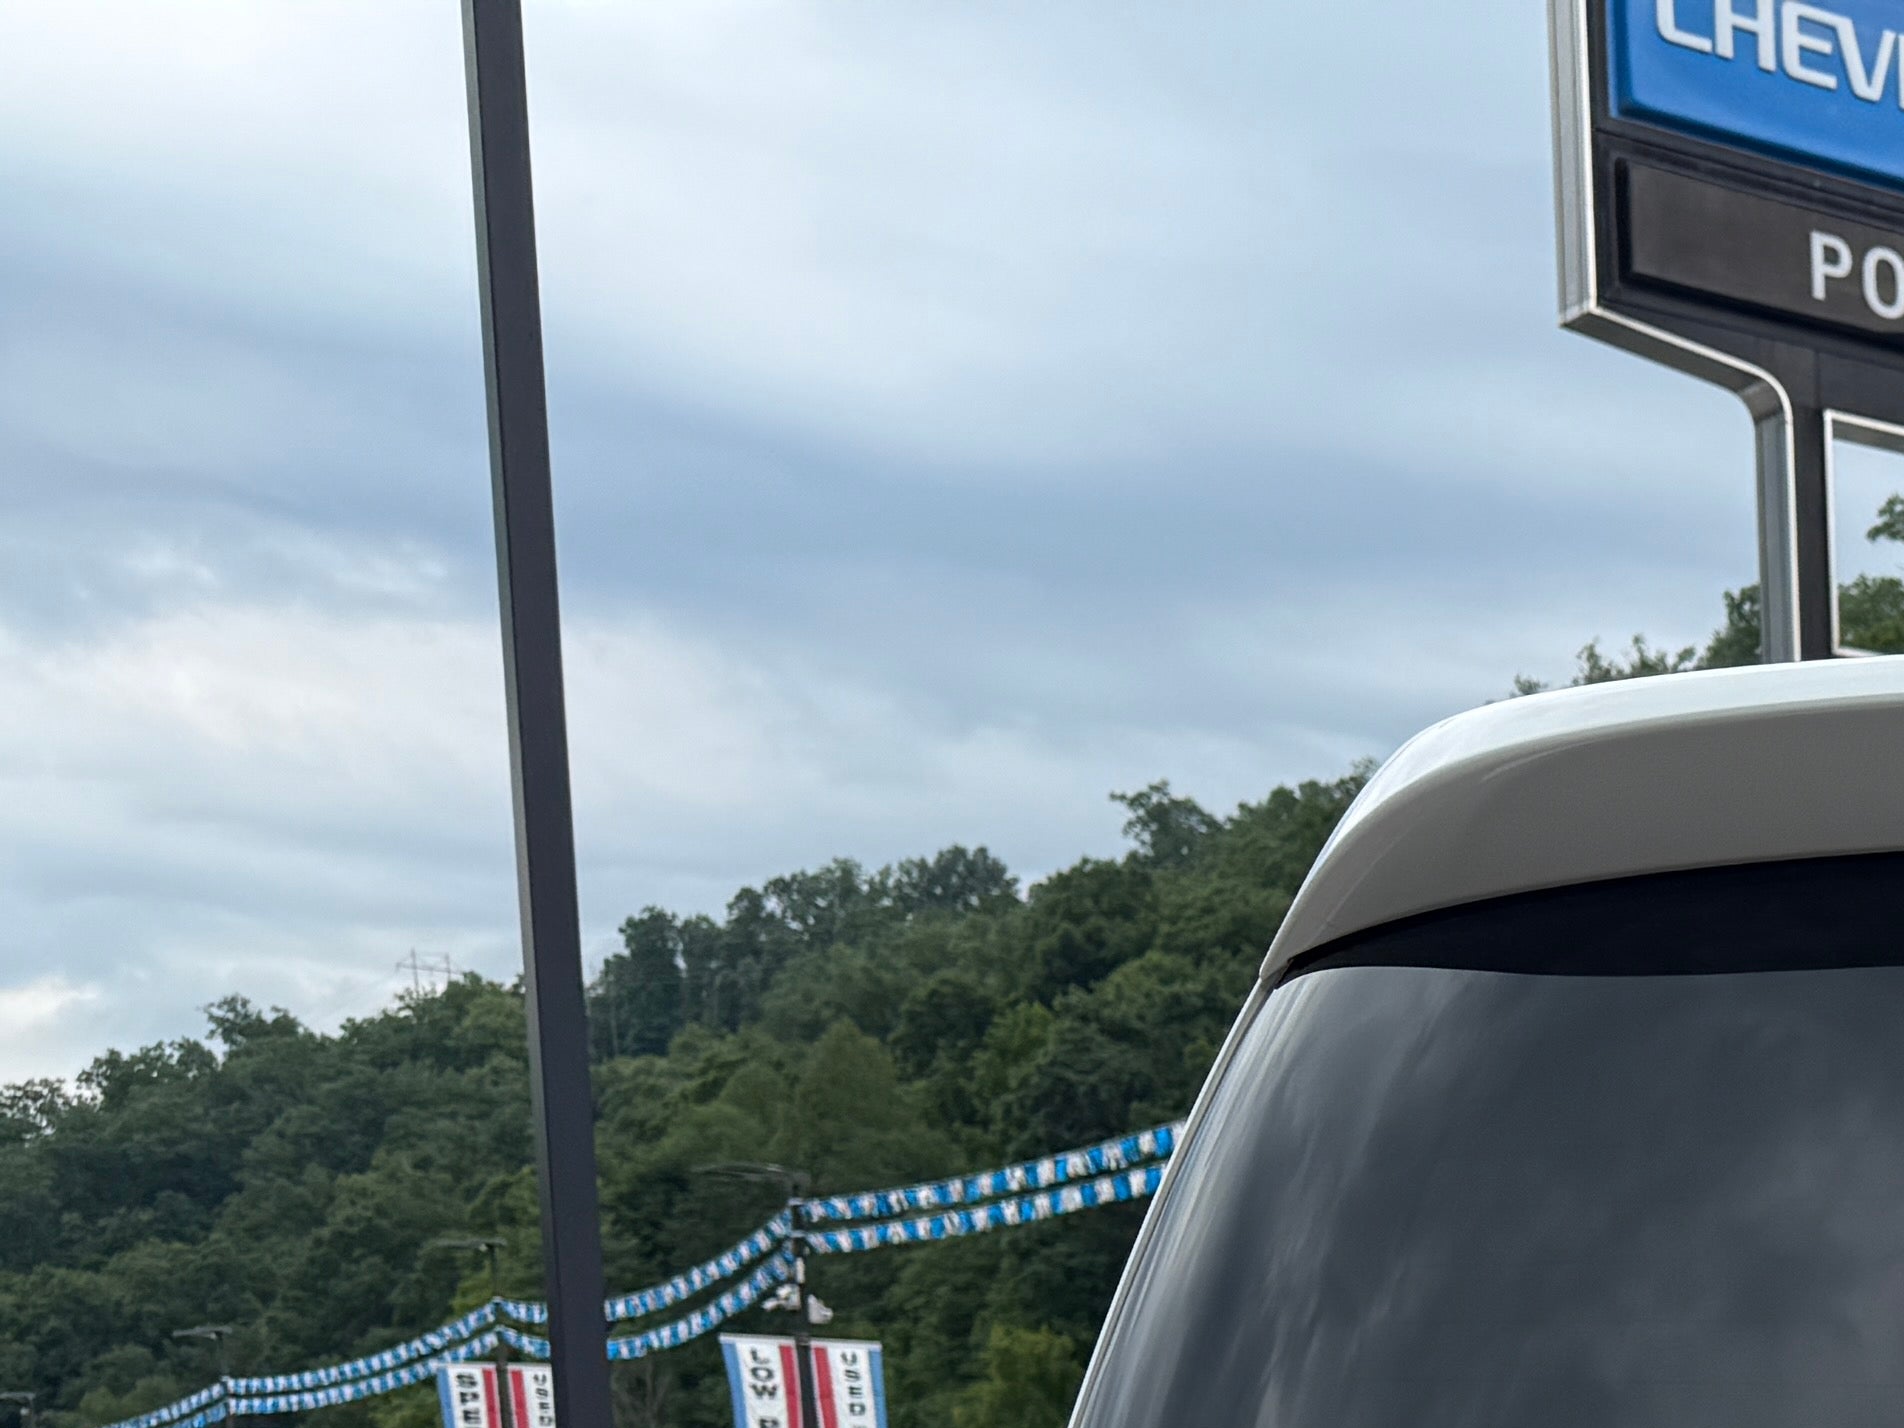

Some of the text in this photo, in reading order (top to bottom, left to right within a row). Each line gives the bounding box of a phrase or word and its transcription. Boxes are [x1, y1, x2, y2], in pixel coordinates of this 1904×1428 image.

[533, 1373, 553, 1428] USED
[750, 1348, 778, 1399] LOW
[840, 1351, 867, 1417] USED
